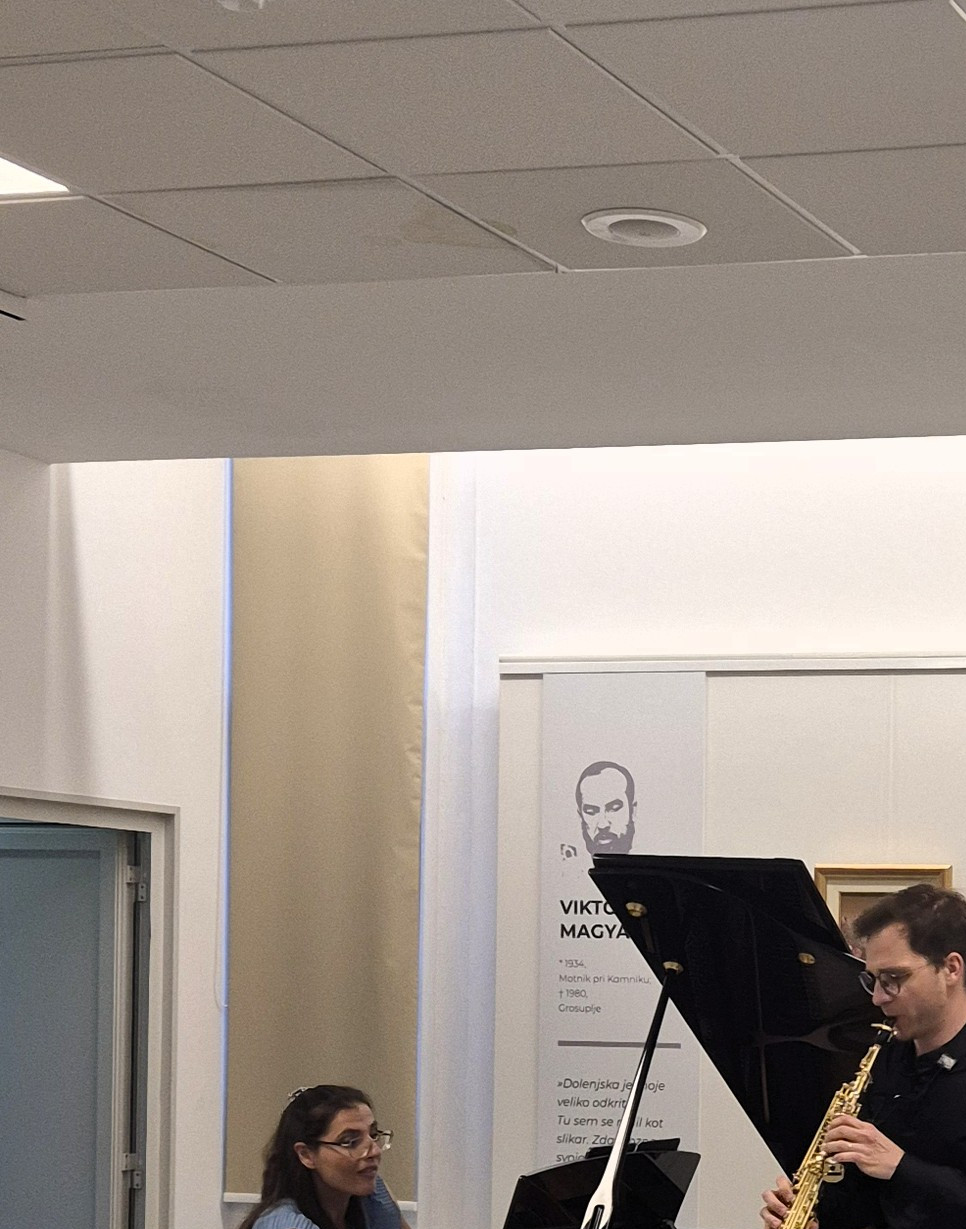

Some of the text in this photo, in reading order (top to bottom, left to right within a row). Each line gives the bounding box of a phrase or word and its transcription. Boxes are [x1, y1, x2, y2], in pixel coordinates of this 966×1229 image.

[560, 900, 616, 915] VIKTO
[560, 924, 630, 939] MAGYA
[558, 974, 591, 983] Motnik
[593, 975, 605, 984] pri
[557, 1078, 665, 1094] »Dolenjska je oje
[557, 1096, 590, 1108] veliko
[557, 1114, 571, 1126] Tu
[573, 1117, 598, 1126] sem
[601, 1118, 614, 1127] se
[645, 1117, 664, 1128] kot
[556, 1133, 589, 1145] slikar.
